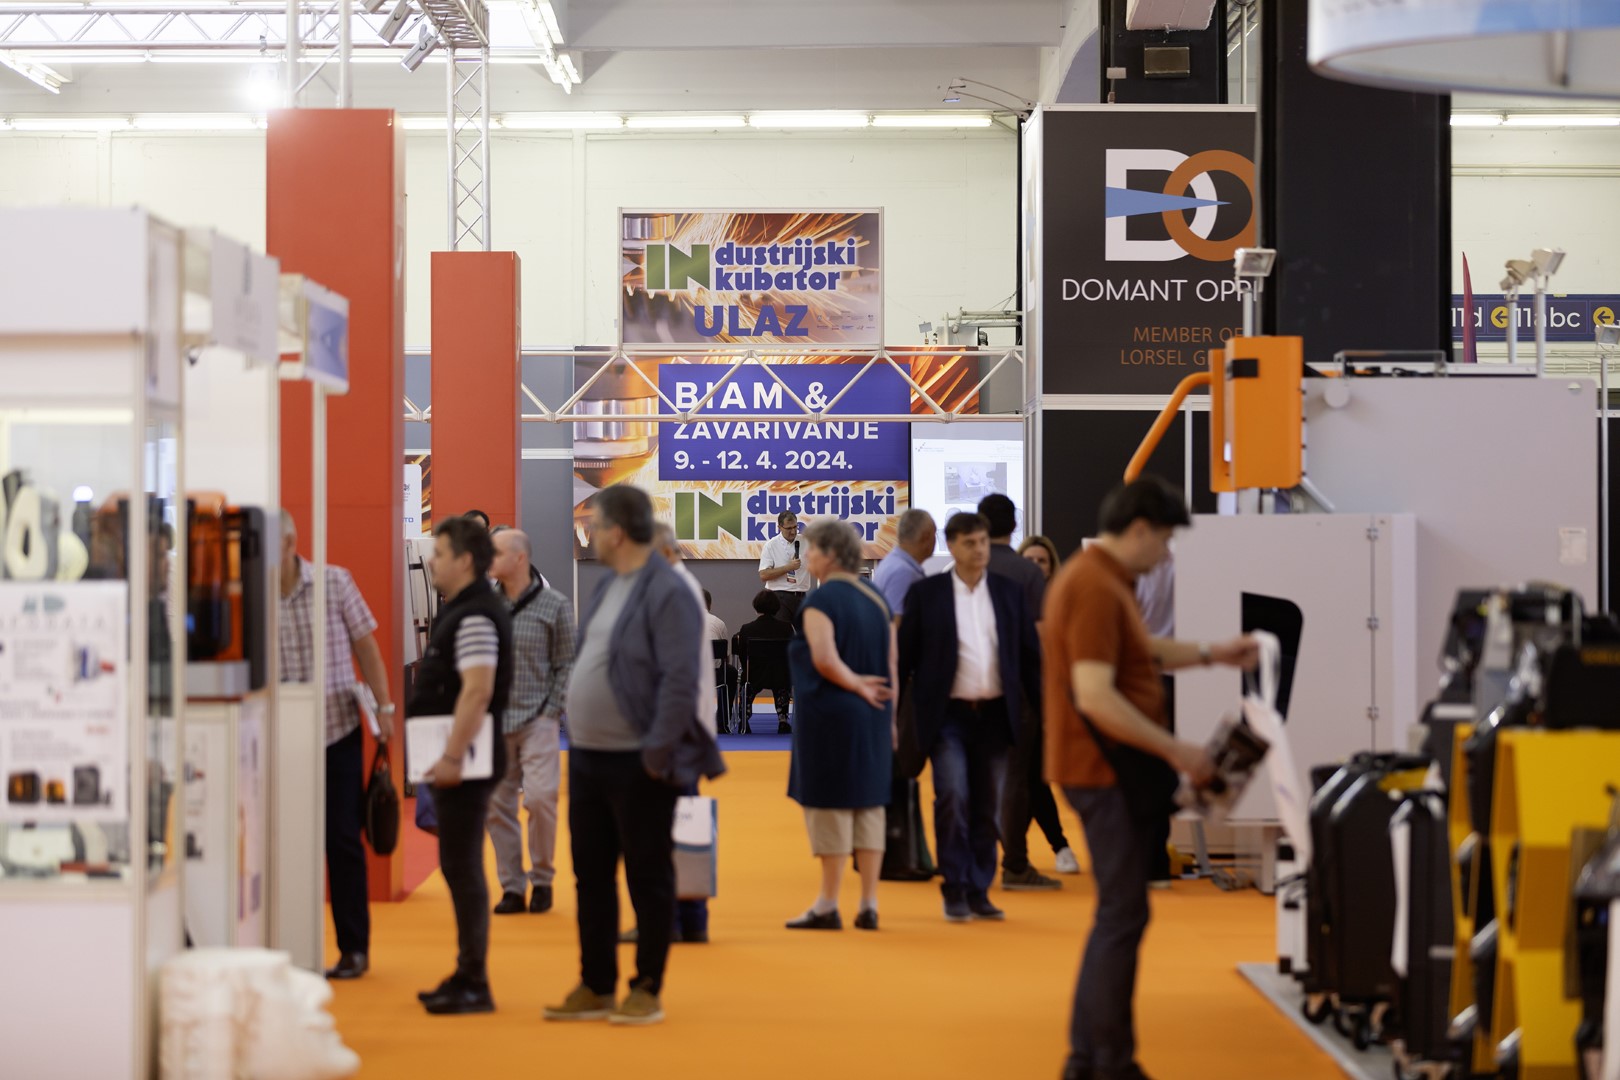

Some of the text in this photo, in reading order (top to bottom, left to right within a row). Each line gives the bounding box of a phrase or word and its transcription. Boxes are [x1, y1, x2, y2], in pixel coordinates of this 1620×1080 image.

[715, 267, 841, 291] kubator
[1062, 278, 1188, 301] DOMANT
[694, 305, 809, 337] ULAZ
[1515, 306, 1581, 328] 11bc
[1133, 327, 1213, 343] MEMBER
[1121, 349, 1187, 365] LORSEL
[675, 381, 828, 409] BIAM &
[673, 421, 879, 440] ZAVARIVANJE
[673, 450, 696, 470] 9.
[716, 450, 749, 470] 12.
[756, 450, 778, 470] 4.
[785, 450, 854, 470] 2024.
